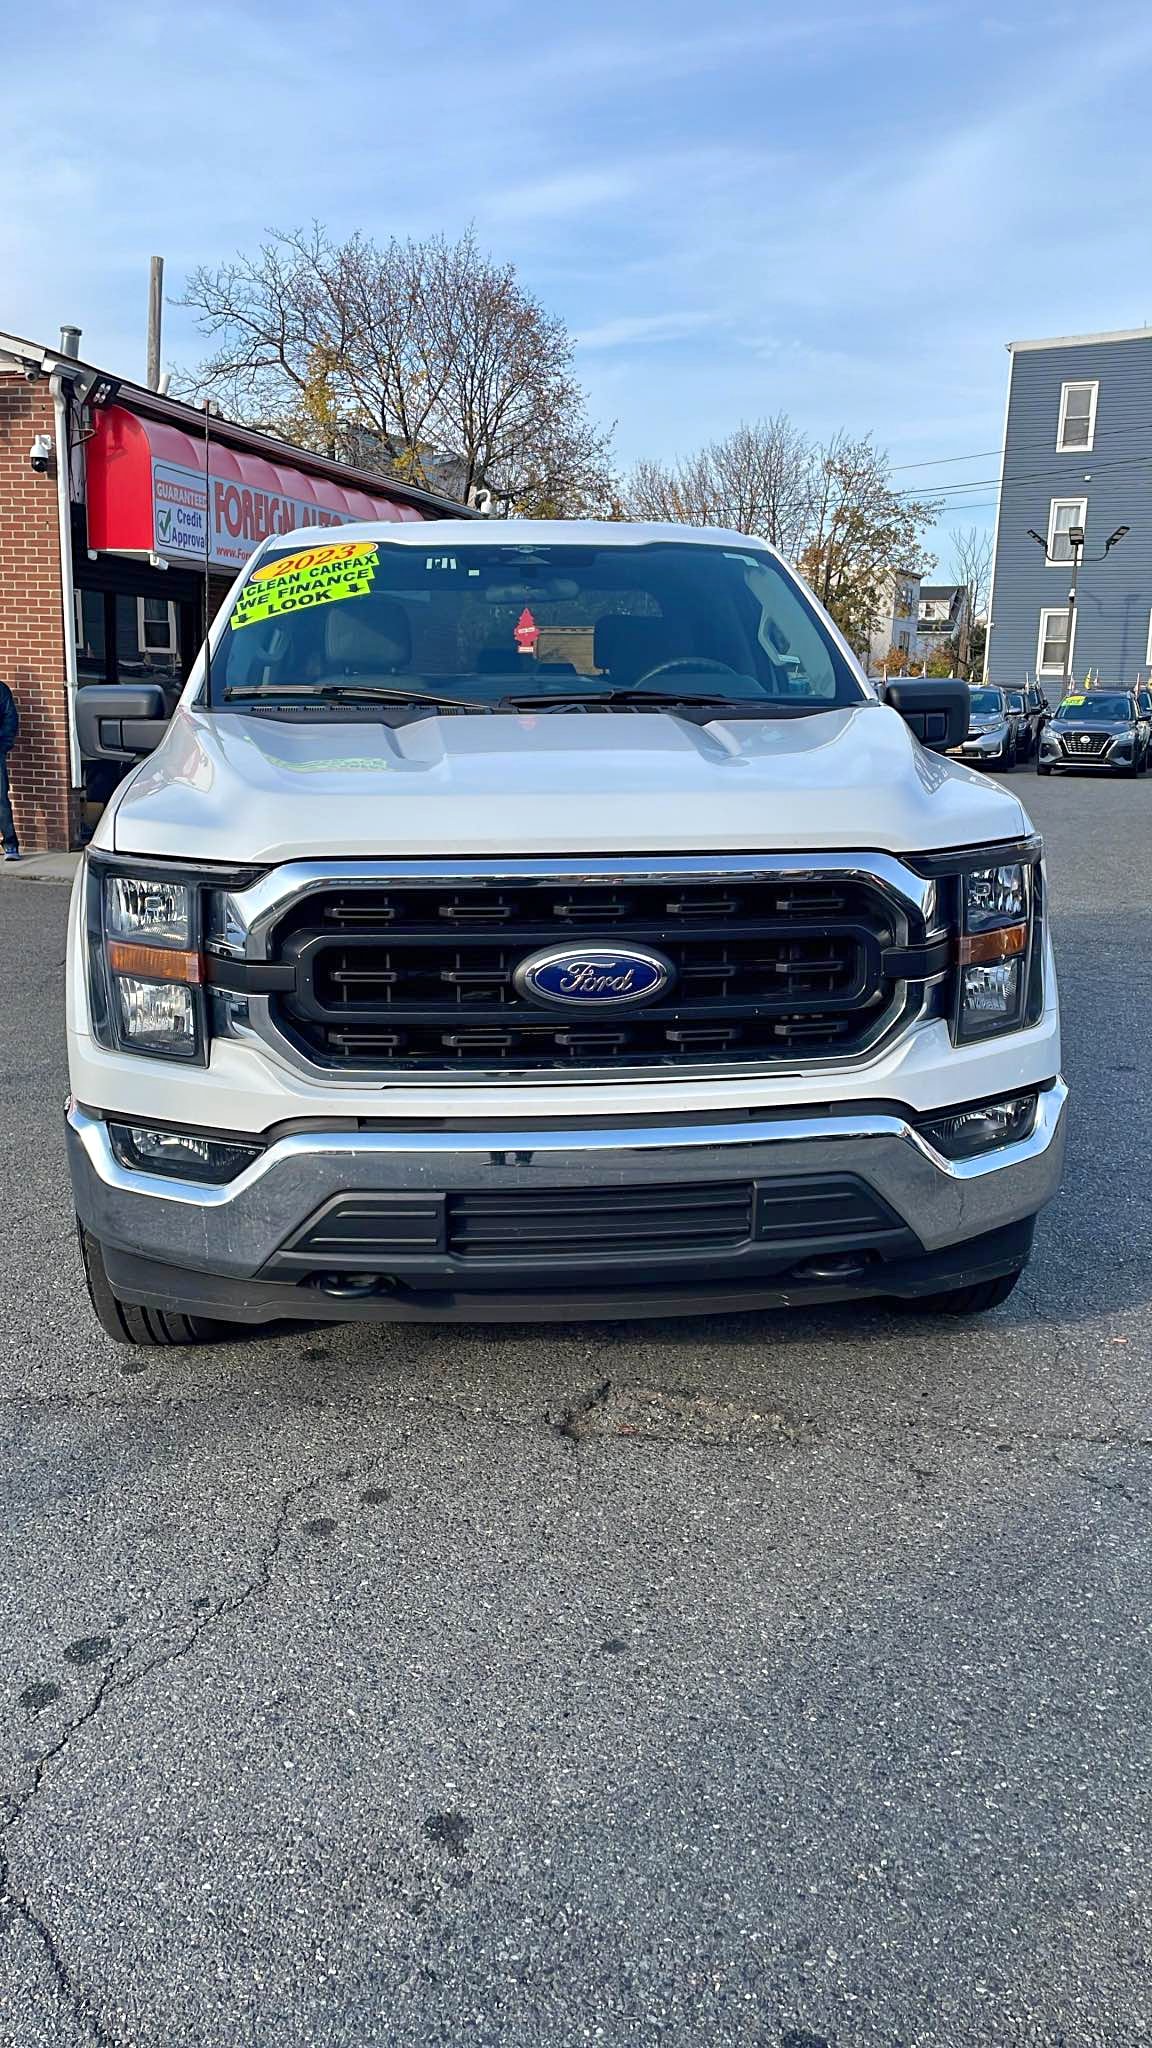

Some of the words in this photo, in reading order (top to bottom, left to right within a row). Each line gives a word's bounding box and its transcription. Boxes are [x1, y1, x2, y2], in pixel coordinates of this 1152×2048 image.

[156, 482, 207, 509] GUARANTEED
[214, 481, 295, 542] FOREIGN
[176, 508, 202, 529] Credit
[246, 572, 301, 597] CLEAN
[309, 553, 375, 578] CARFAX
[273, 544, 358, 578] 2023
[239, 593, 269, 611] WE
[277, 568, 369, 598] FINANCE
[267, 589, 332, 615] LOOK
[559, 961, 635, 993] Ford
